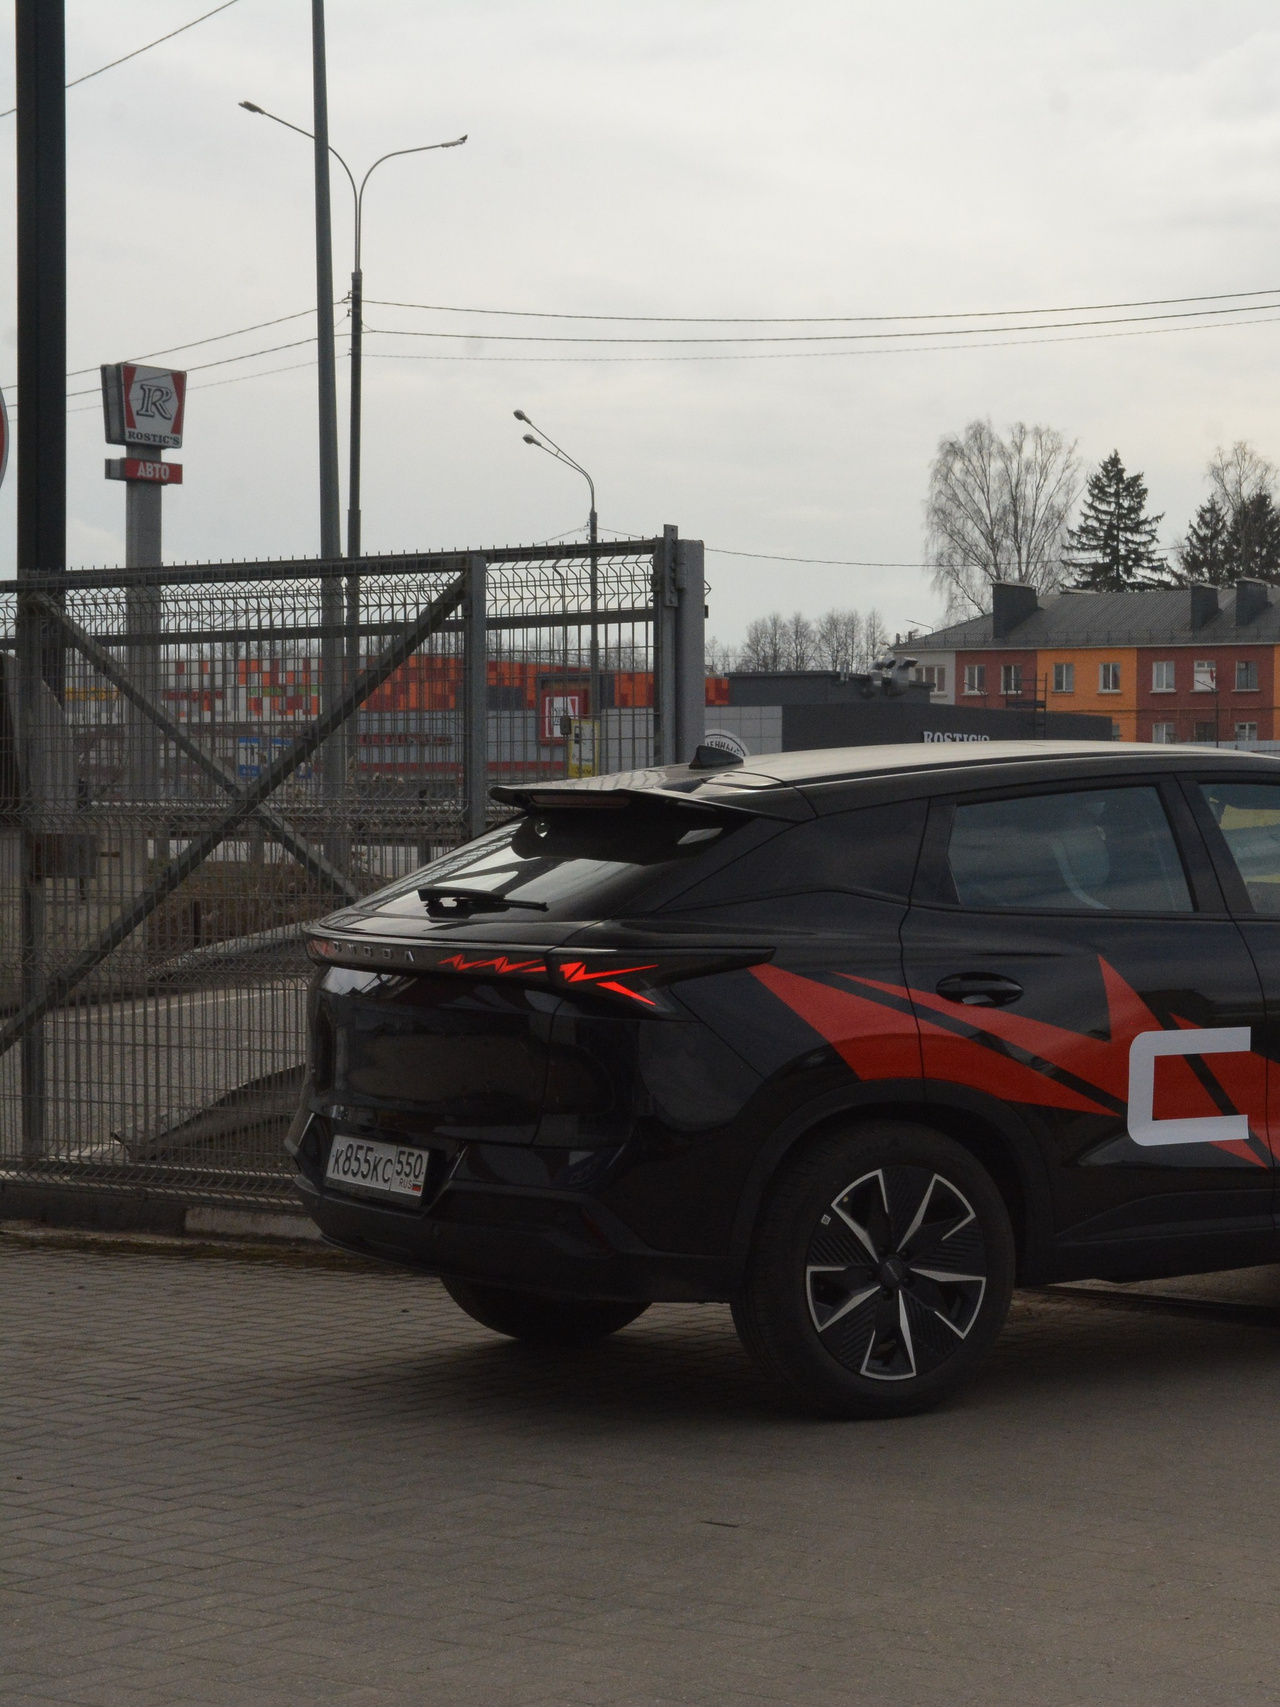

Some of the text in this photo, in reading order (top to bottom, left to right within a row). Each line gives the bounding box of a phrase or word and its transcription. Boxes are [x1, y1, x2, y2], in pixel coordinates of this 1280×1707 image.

[127, 431, 180, 446] ROSTIC'S
[136, 462, 170, 480] АВТО
[395, 1150, 423, 1180] 550
[399, 1178, 412, 1189] RUS
